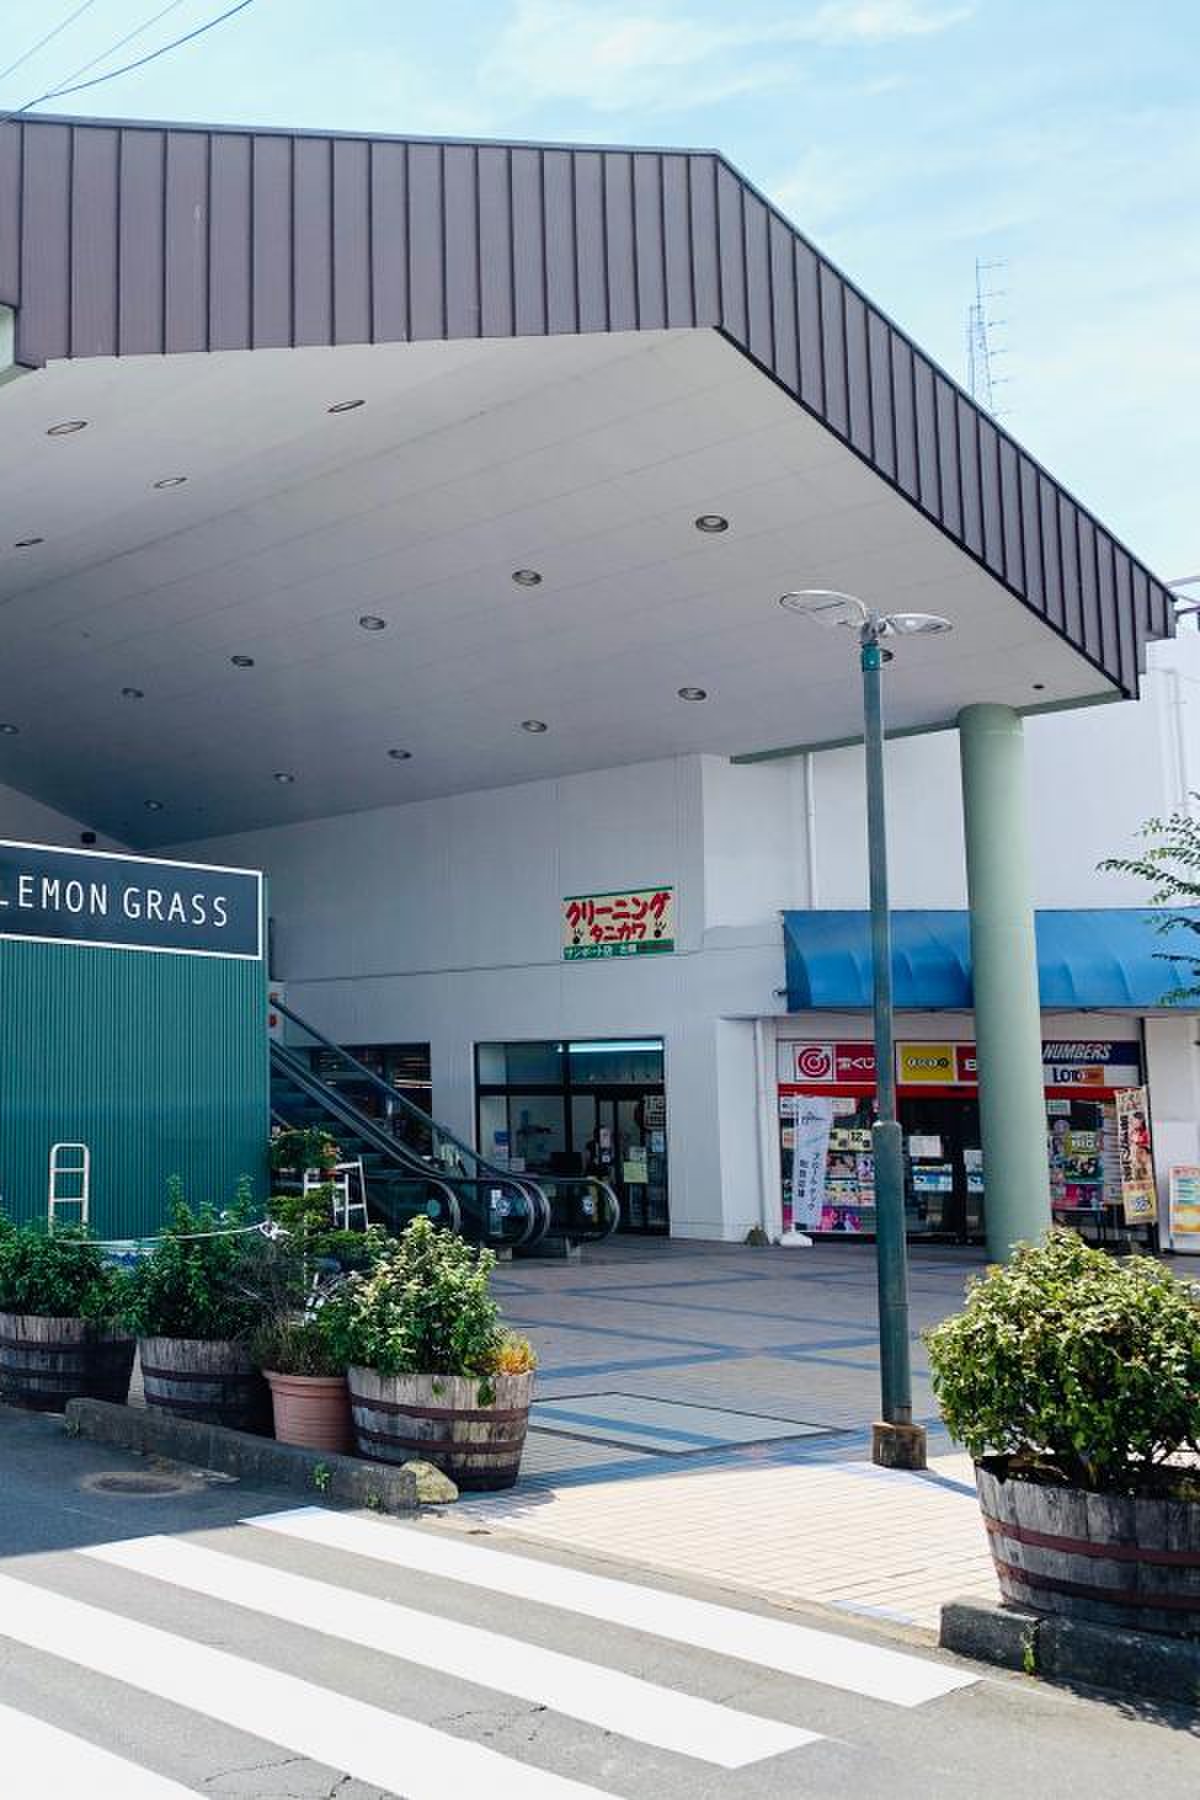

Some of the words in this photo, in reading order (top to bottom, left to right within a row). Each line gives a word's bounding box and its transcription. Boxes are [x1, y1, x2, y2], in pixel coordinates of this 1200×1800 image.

[123, 887, 228, 928] GRASS
[565, 892, 672, 928] クリーニング
[590, 922, 647, 943] タニカワ
[1042, 1042, 1113, 1060] NUMBERS
